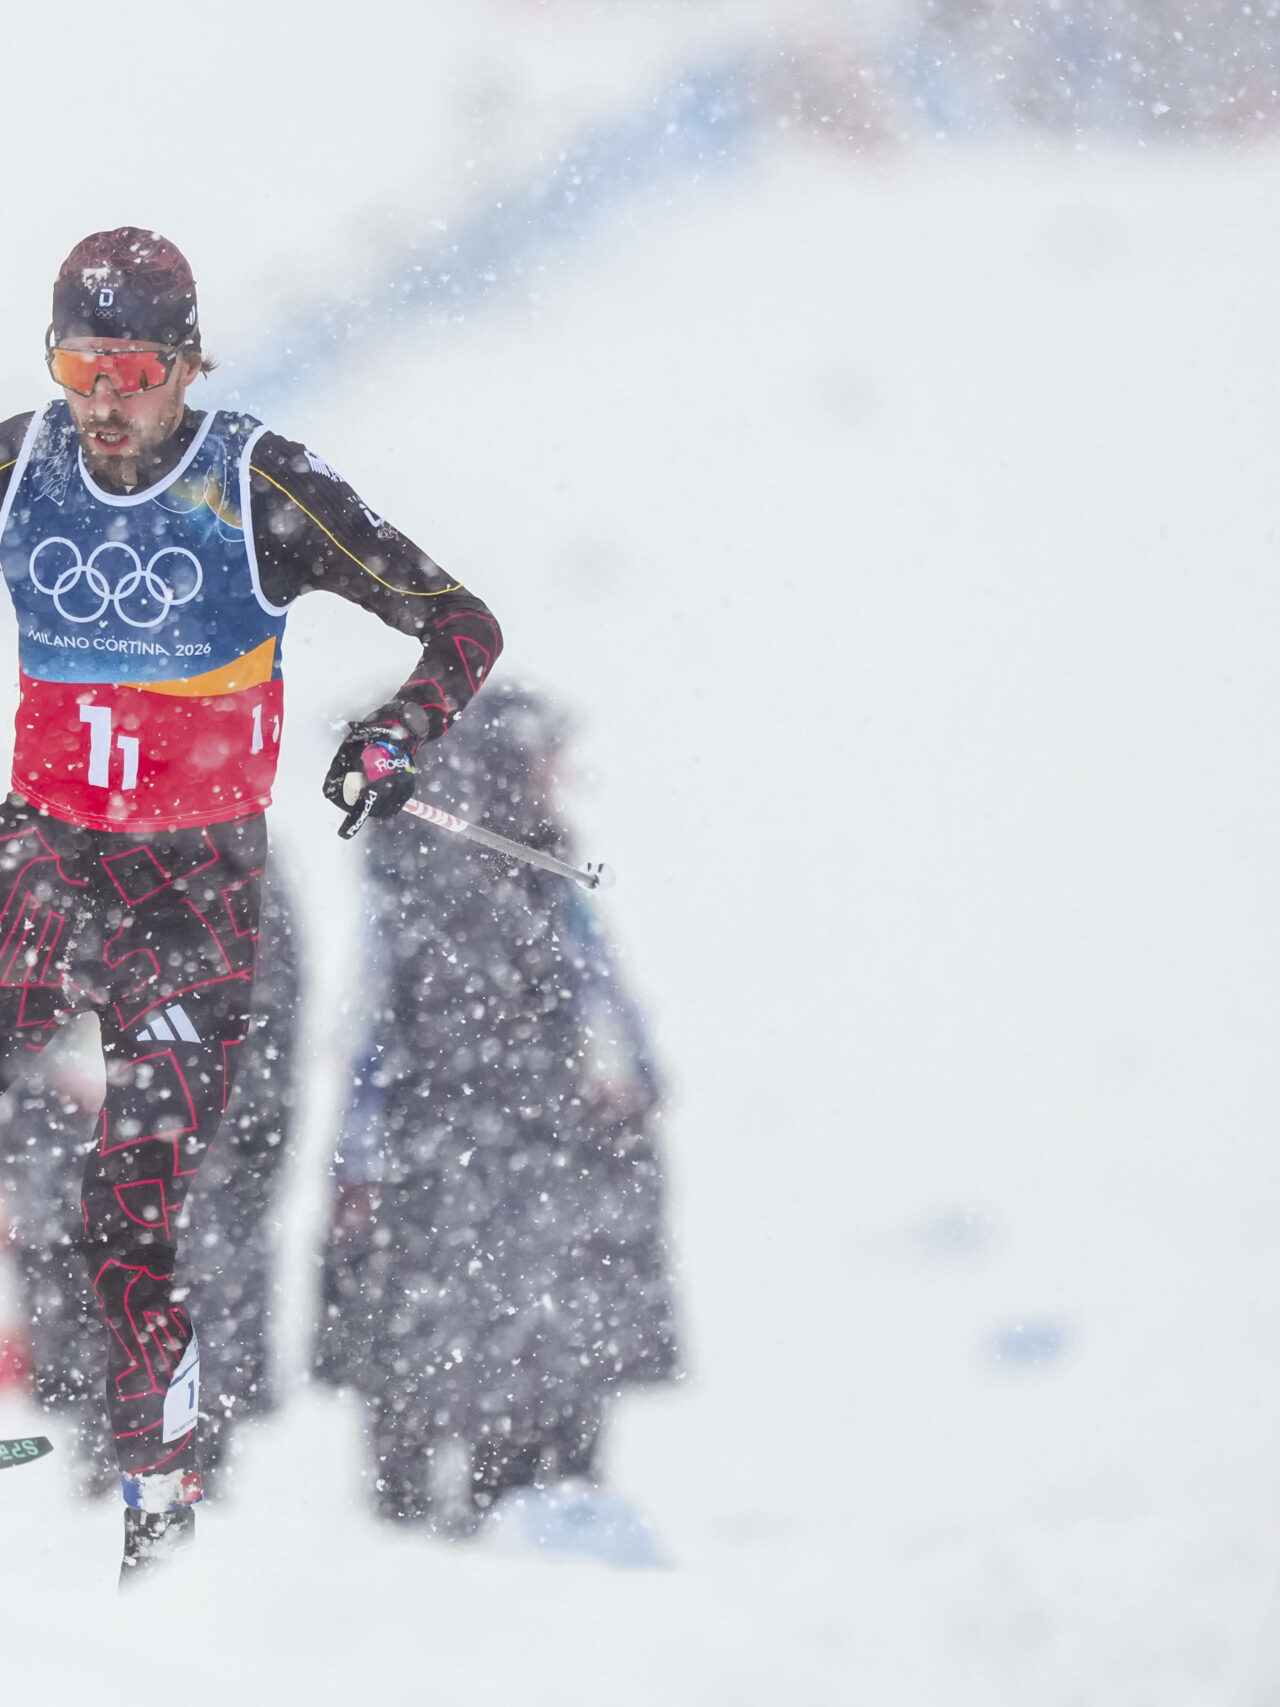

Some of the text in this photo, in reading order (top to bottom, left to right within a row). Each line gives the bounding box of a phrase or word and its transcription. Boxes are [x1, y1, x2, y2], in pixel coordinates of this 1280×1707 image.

[99, 288, 114, 307] D
[28, 629, 211, 657] MILANO CORTINA 2026
[347, 789, 378, 836] Roeckl
[188, 1379, 195, 1410] 1
